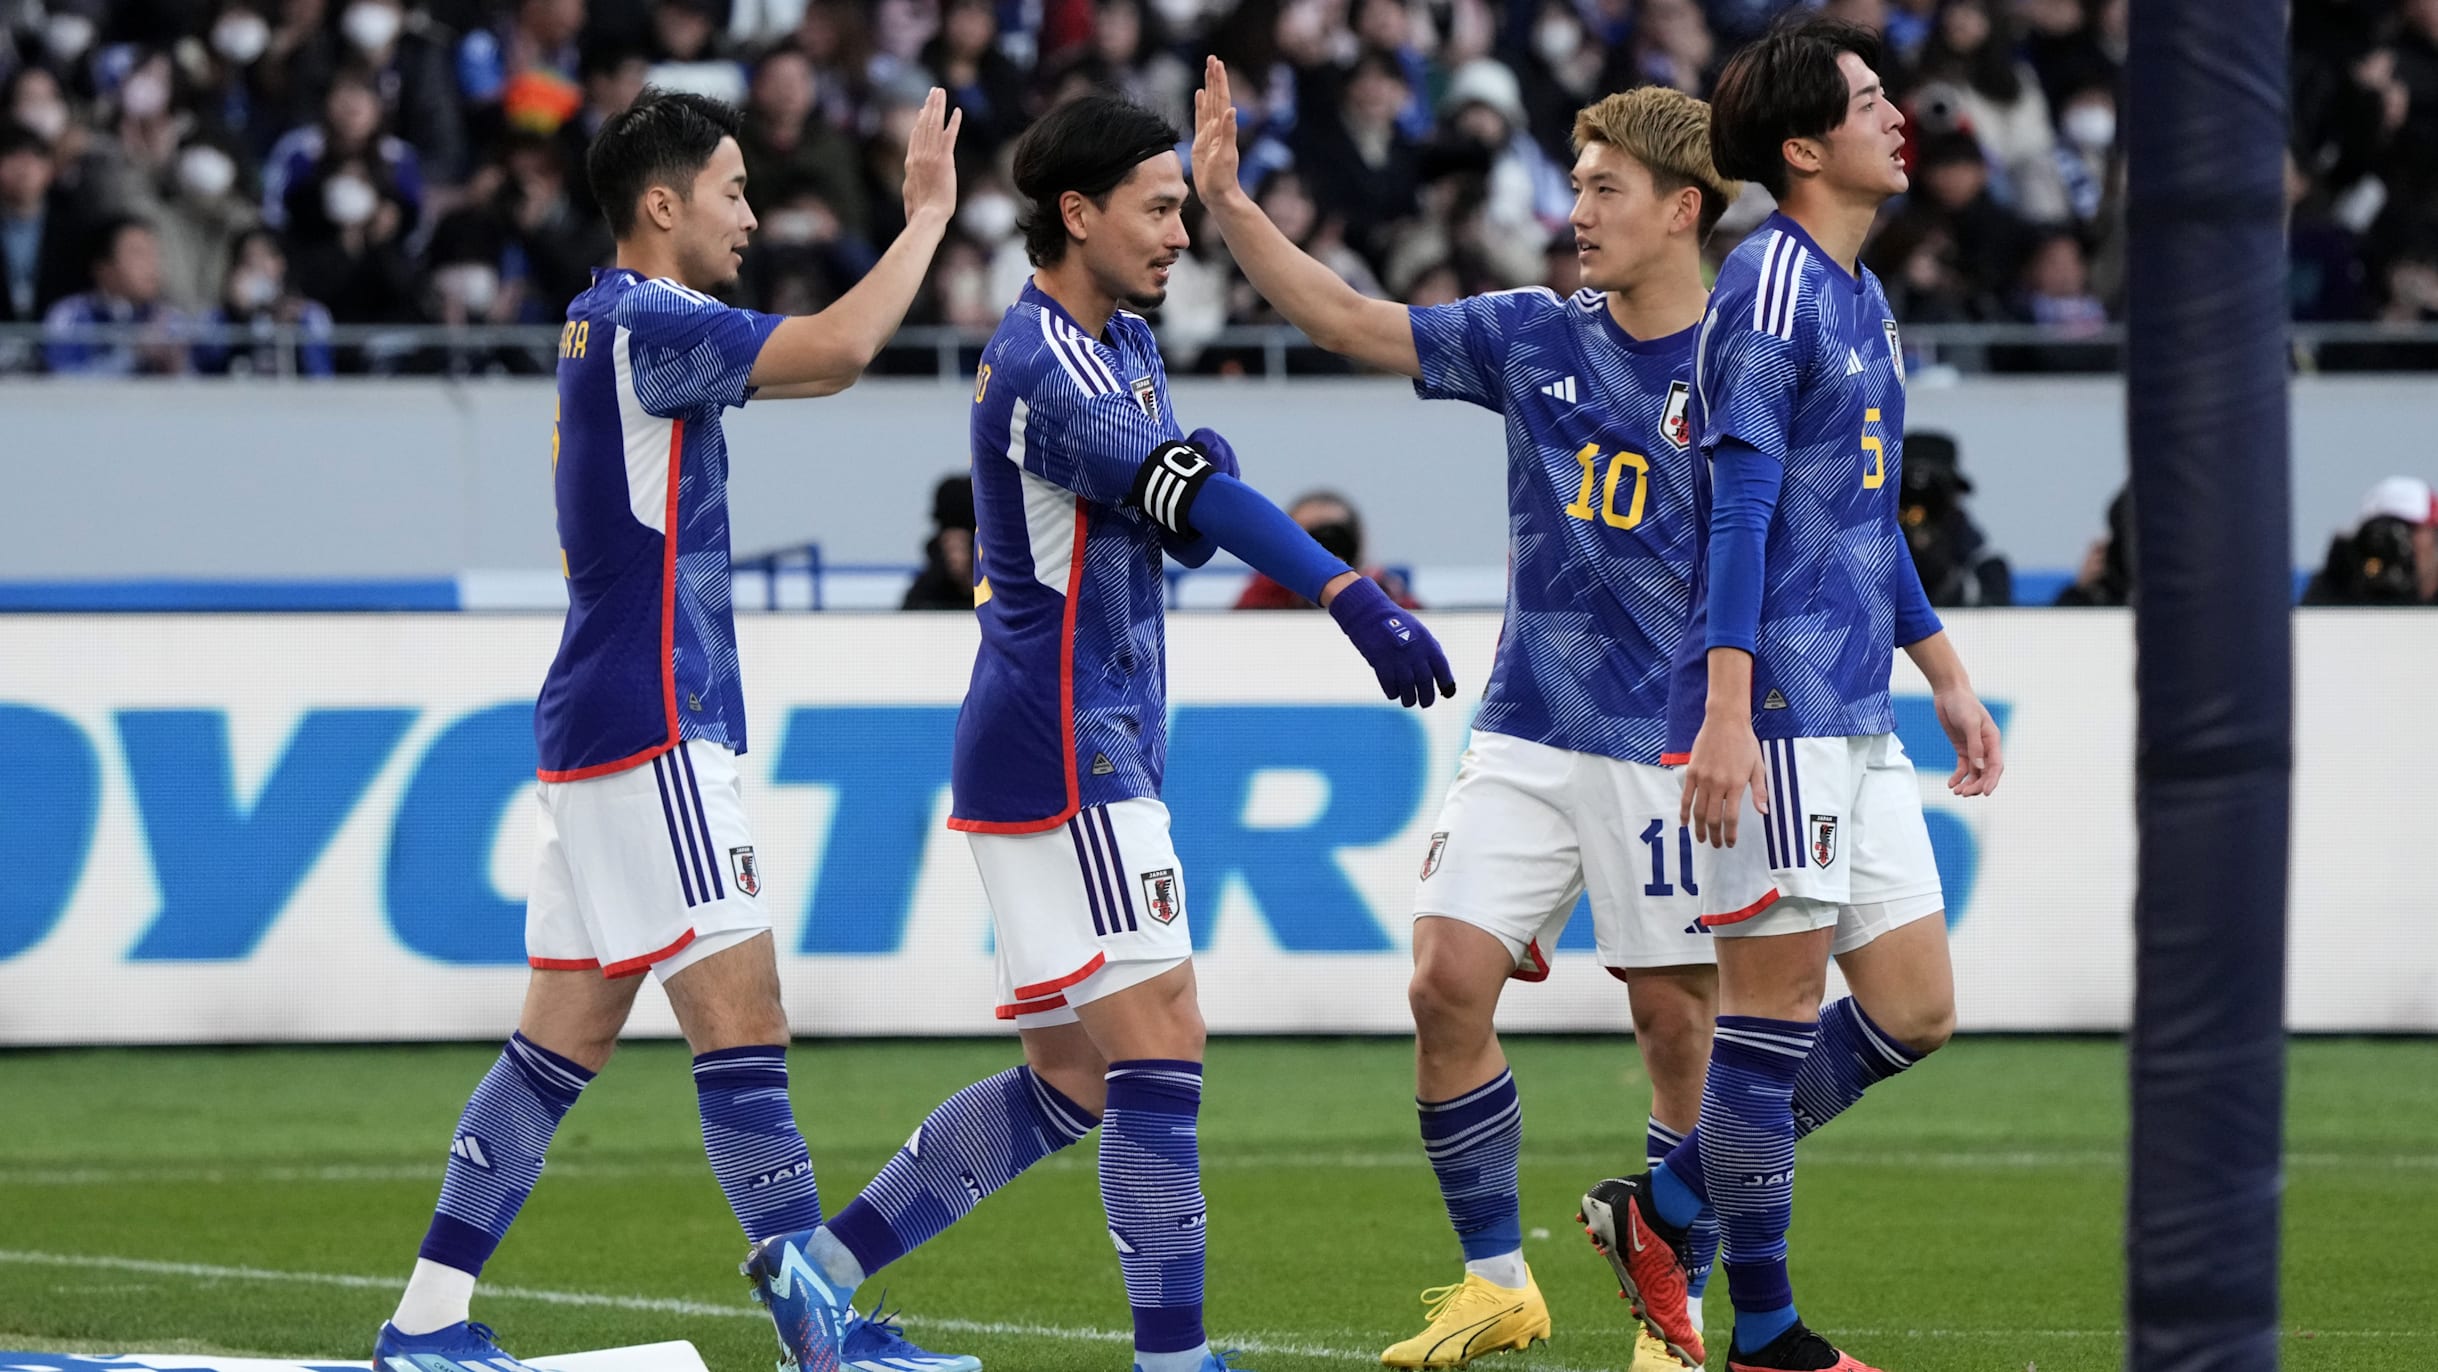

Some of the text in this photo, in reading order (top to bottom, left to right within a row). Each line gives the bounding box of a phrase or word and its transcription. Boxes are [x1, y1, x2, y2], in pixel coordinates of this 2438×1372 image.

[1565, 442, 1649, 530] 10
[1861, 408, 1884, 489] 5
[752, 1158, 813, 1189] JAP
